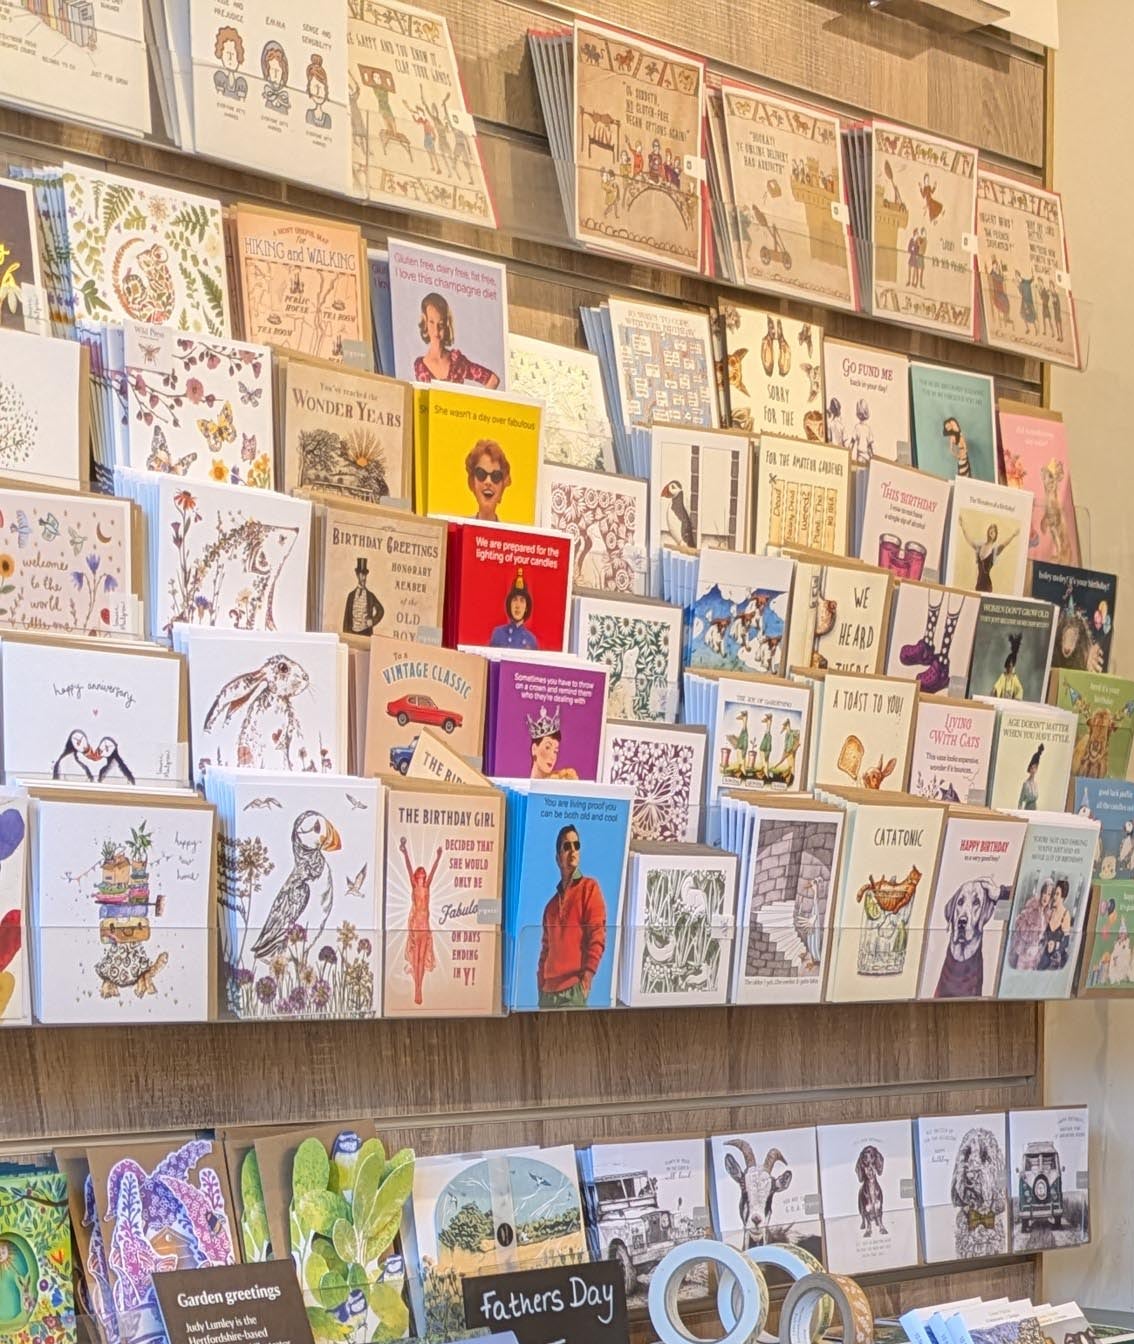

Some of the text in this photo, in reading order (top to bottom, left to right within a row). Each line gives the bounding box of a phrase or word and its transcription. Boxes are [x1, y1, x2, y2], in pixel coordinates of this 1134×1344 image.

[244, 238, 356, 271] HIKING and WALKING
[394, 252, 418, 266] Gluten
[437, 261, 453, 278] dairy
[400, 269, 416, 282] love
[417, 273, 432, 285] this
[434, 276, 481, 298] champagne
[842, 358, 893, 381] GO FUND ME
[292, 388, 401, 427] WONDER YEARS
[434, 405, 535, 430] She wasn't day over fabulous
[881, 481, 937, 512] THIS BIRTHDAY
[332, 527, 439, 559] BIRTHDAY GREETINGS
[476, 536, 559, 556] We are prepared for the
[22, 552, 68, 571] welcome
[476, 549, 558, 568] lighting of your candles
[392, 562, 432, 578] HONORARY
[30, 598, 61, 612] world
[854, 587, 870, 609] WE
[396, 612, 420, 625] OLD
[839, 623, 873, 647] HEARD
[383, 662, 472, 699] VINTAGE CLASSIC
[514, 673, 546, 685] Sometimes
[547, 677, 557, 687] you
[558, 677, 571, 687] have
[579, 680, 594, 689] throw
[528, 684, 592, 697] crown and remind them
[54, 681, 136, 708] happy anniversary
[834, 690, 904, 716] A TOAST TO YOU!
[945, 713, 972, 733] LIVING
[929, 730, 980, 748] WITH CATS
[424, 751, 444, 776] THE
[544, 798, 617, 812] You are living proof you
[399, 807, 495, 828] THE BIRTHDAY GIRL
[554, 810, 562, 818] be
[564, 810, 578, 819] both
[580, 812, 590, 820] old
[604, 814, 618, 822] cool
[445, 838, 493, 851] DECIDED THAT
[874, 828, 924, 848] CATATONIC
[960, 840, 1009, 853] HAPPY BIRTHDAY
[449, 858, 488, 869] SHE WOULD
[454, 876, 483, 888] ONLY BE
[439, 900, 479, 925] Fabulo
[452, 932, 480, 943] ON DAYS
[452, 949, 478, 961] ENDING
[453, 968, 461, 978] IN
[177, 1284, 281, 1308] Garden greetings
[480, 1277, 614, 1325] Fathers Day
[186, 1316, 257, 1333] Judy Lumley is the
